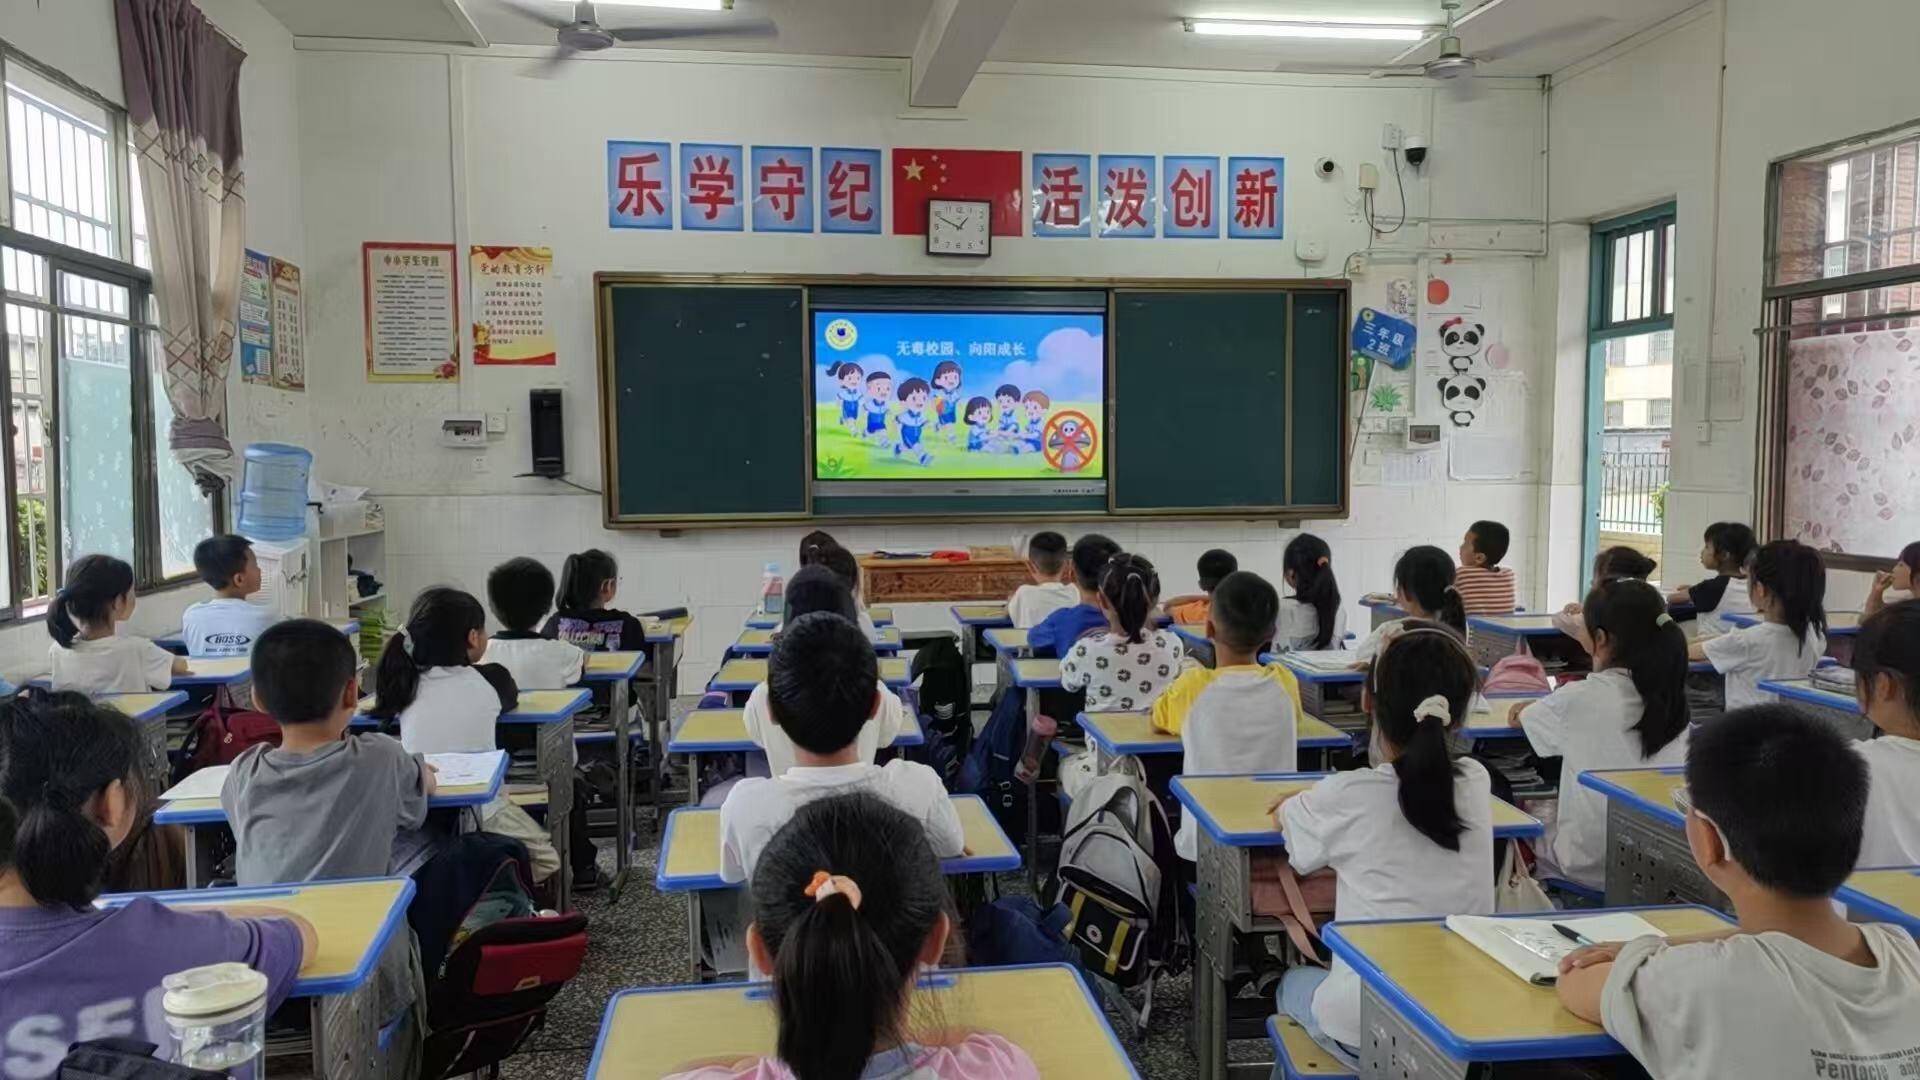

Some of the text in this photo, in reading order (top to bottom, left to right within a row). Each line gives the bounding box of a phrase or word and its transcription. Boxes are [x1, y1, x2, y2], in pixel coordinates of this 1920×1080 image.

[616, 152, 873, 222] 乐学守纪
[1040, 165, 1278, 229] 活泼创新
[480, 263, 545, 276] 党的教育方针
[1361, 321, 1406, 346] 三年级
